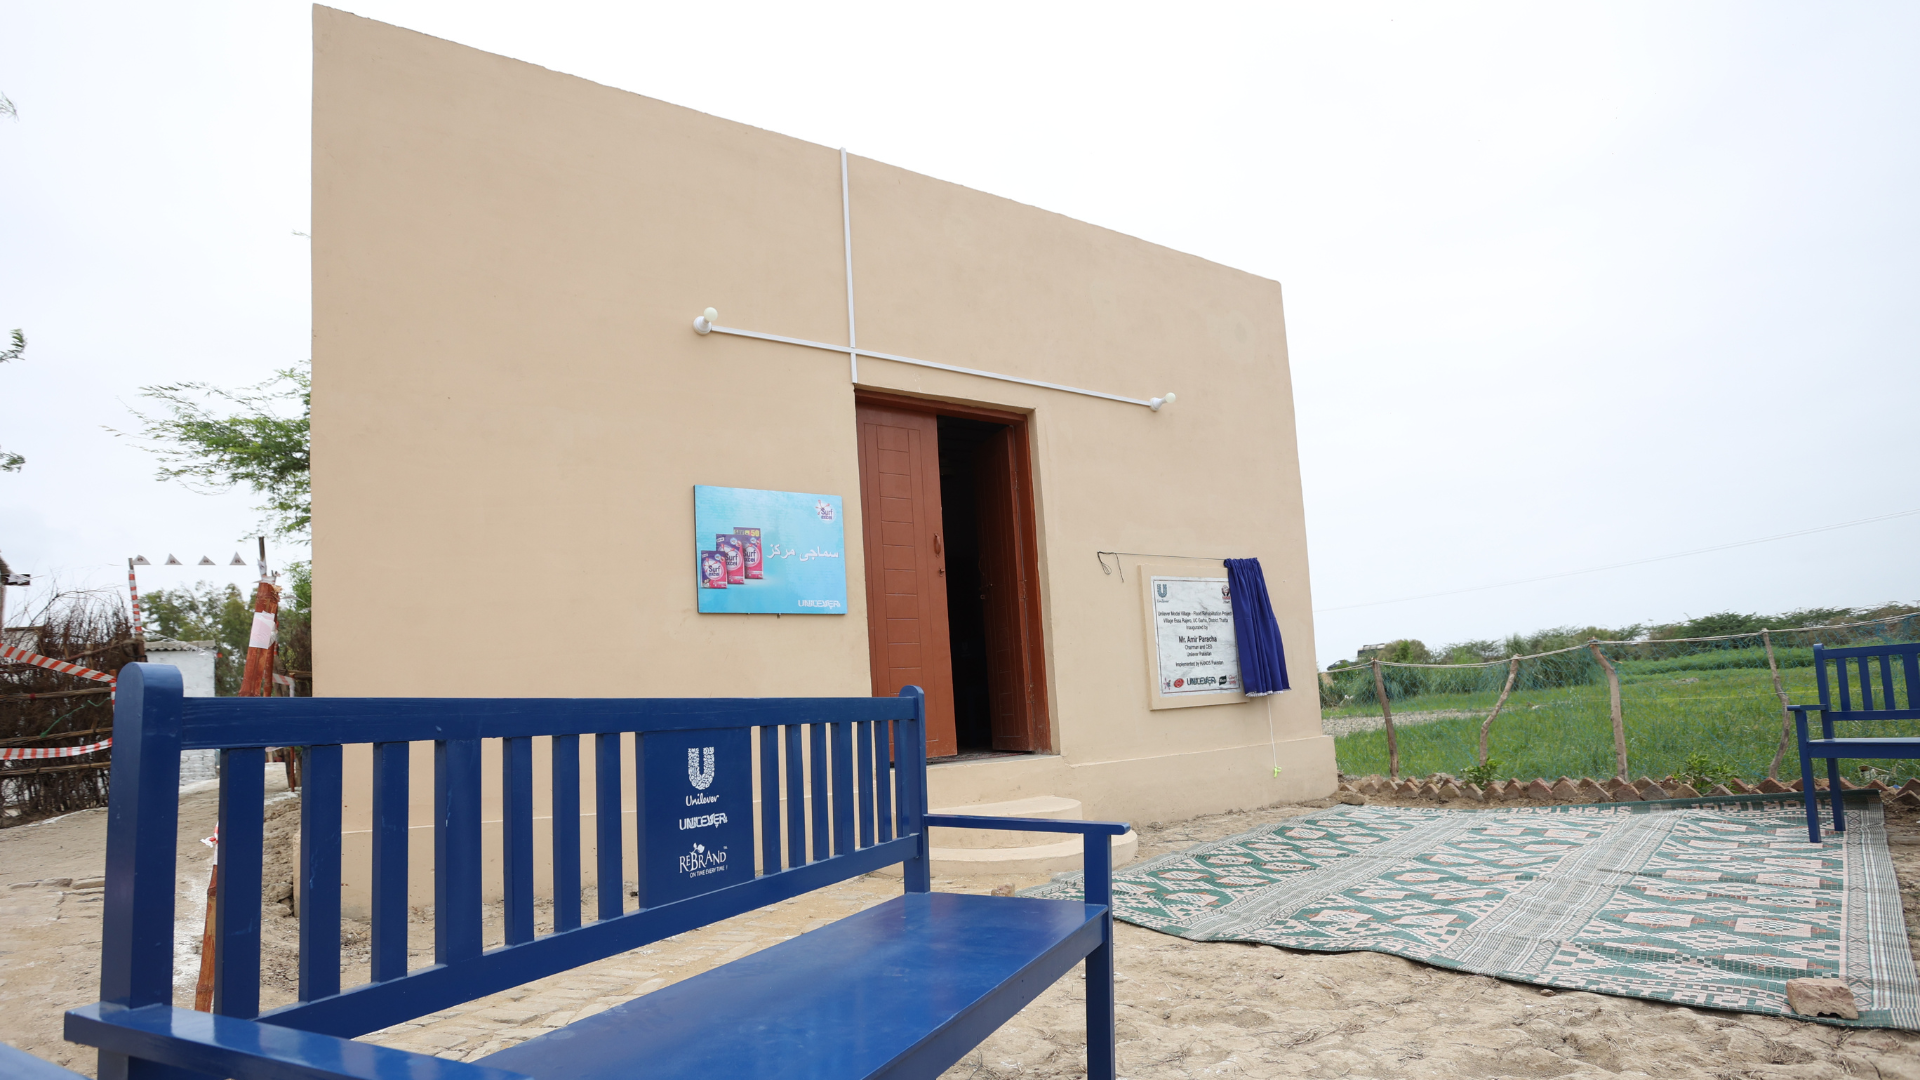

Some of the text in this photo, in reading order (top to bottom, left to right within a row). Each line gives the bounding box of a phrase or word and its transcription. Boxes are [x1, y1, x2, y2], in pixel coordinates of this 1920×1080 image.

[820, 507, 833, 517] Surf
[708, 565, 721, 573] Surf
[1178, 635, 1217, 643] Mr. Amir Paracha
[685, 792, 720, 806] Unilever
[696, 869, 706, 877] TIME
